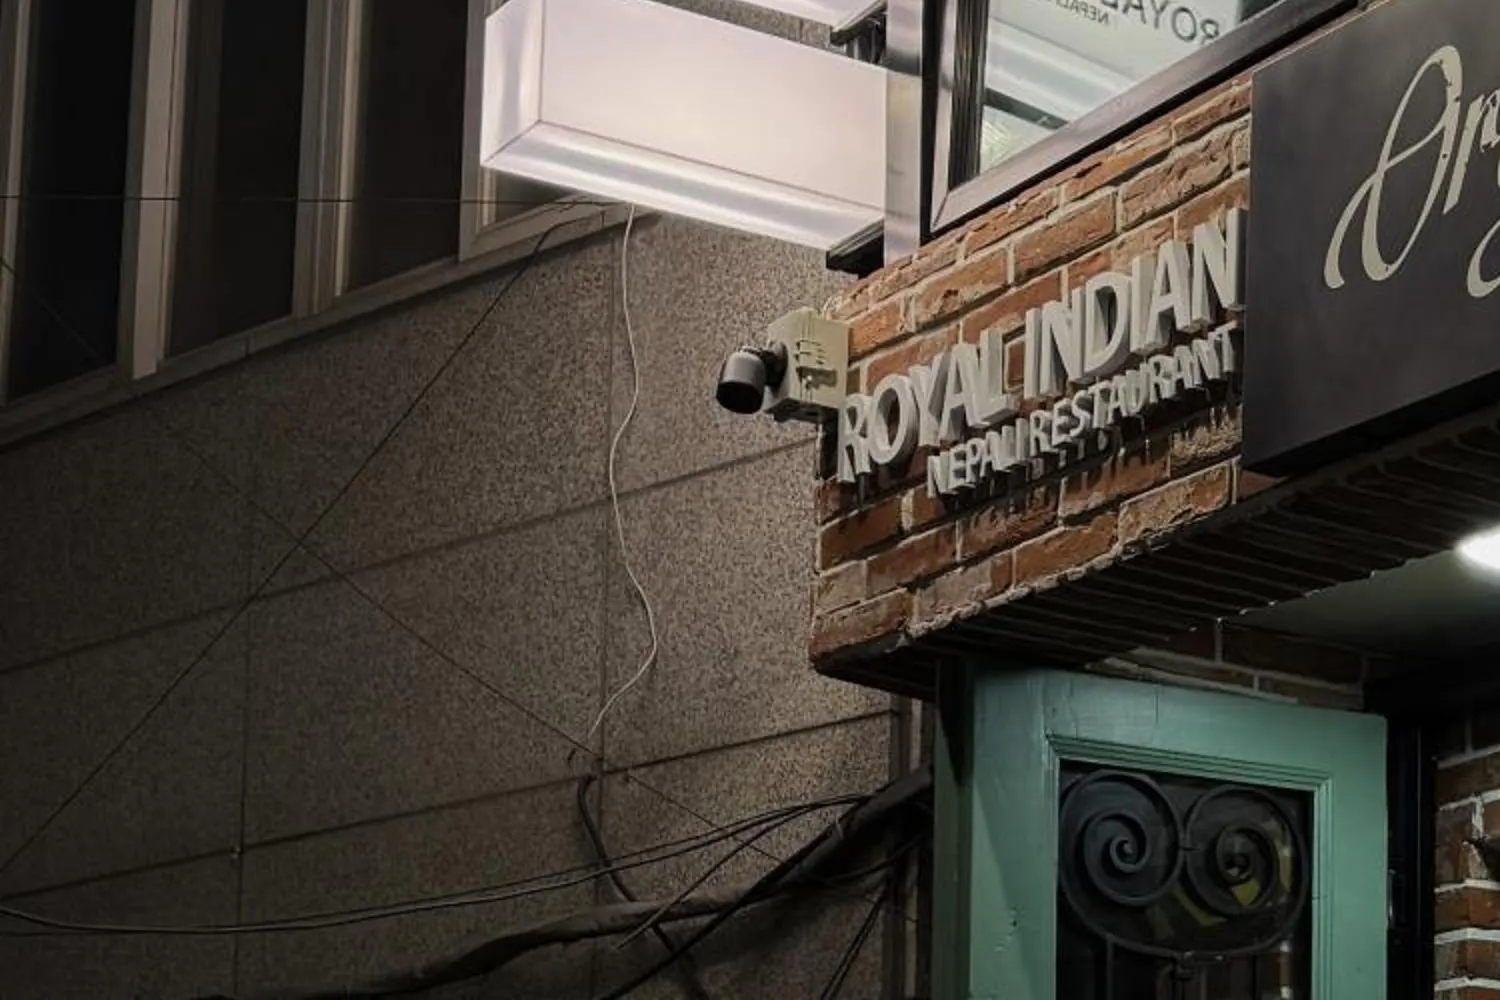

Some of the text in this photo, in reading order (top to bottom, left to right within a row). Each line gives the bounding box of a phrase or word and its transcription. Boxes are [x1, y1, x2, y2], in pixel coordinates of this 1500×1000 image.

[837, 207, 1247, 483] ROYAL INDIAN
[926, 321, 1239, 497] NEPALI RESTAURANT
